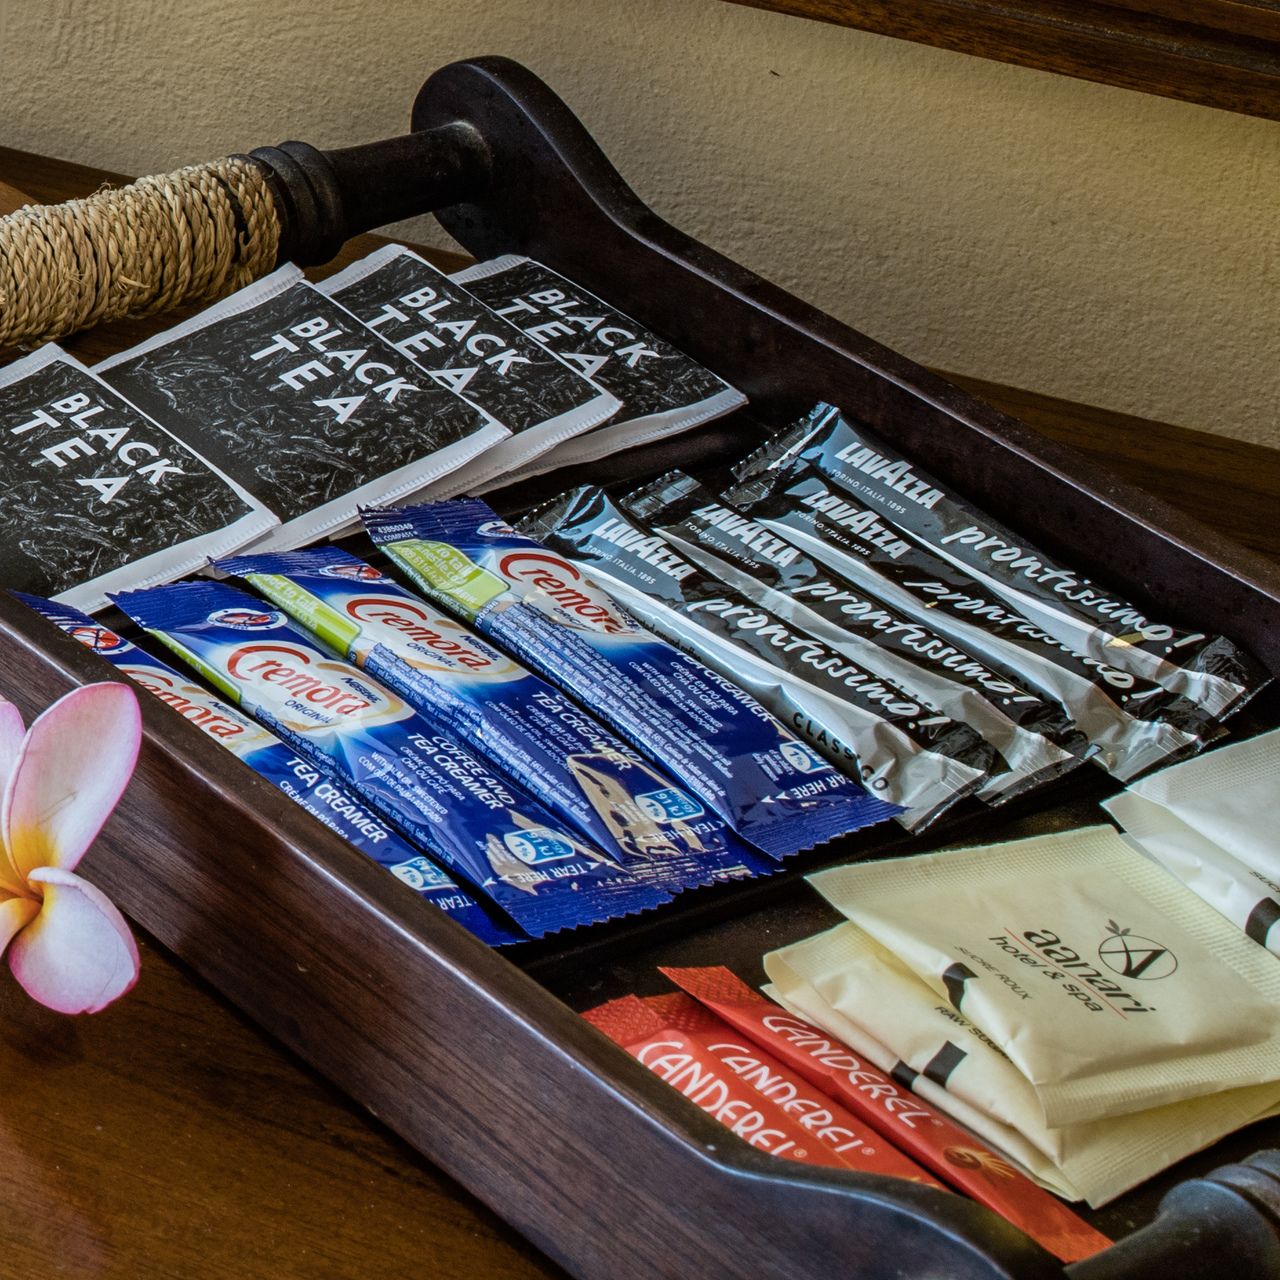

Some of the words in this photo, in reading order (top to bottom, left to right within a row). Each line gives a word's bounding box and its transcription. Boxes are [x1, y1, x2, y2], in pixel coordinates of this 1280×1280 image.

[289, 315, 420, 404] BLACK
[366, 303, 480, 394] TEA
[398, 285, 533, 376] BLACK
[495, 298, 611, 379] TEA
[528, 287, 661, 369] BLACK
[249, 333, 366, 425] TEA
[10, 409, 130, 505] TEA
[50, 391, 187, 486] BLACK
[834, 441, 946, 511] LAVAZZA
[886, 500, 908, 516] 1895
[592, 517, 697, 582] LAVAZZA
[690, 503, 805, 569] LAVAZZA
[799, 489, 914, 561] LAVAZZA
[849, 543, 873, 558] 1895
[638, 571, 657, 585] 1895
[940, 525, 1206, 653] prontissimo!
[346, 598, 493, 671] Cremora
[406, 642, 457, 668] ORIGINAL
[686, 597, 953, 731] prontissimo!
[790, 580, 1043, 706] prontissimo!
[121, 668, 246, 738] Cemora
[227, 645, 372, 716] Cremora
[284, 699, 335, 725] ORIGINAL
[641, 661, 661, 677] WITH
[657, 672, 676, 690] PALM
[684, 698, 723, 728] SWEETENED
[687, 683, 702, 696] OU
[694, 677, 710, 692] EM
[717, 695, 739, 716] PARA
[703, 668, 774, 723] CREAMER
[531, 691, 564, 714] TEA
[559, 713, 632, 771] CREAMER
[605, 735, 643, 764] AND
[286, 756, 321, 789] TEA
[314, 783, 389, 844] CREAMER
[407, 732, 440, 757] TEA
[433, 754, 504, 810] CREAMER
[415, 766, 429, 780] OU
[426, 764, 440, 778] EM
[446, 780, 466, 802] PARA
[431, 735, 491, 777] COFFEE
[478, 775, 516, 806] AND
[655, 792, 673, 805] 91
[790, 779, 827, 799] HERE
[441, 894, 474, 911] TEAR
[512, 871, 547, 884] HERE
[548, 862, 589, 879] TEAR
[988, 935, 1043, 968] hotel
[1043, 968, 1065, 981] &
[1062, 982, 1105, 1012] spa
[996, 972, 1033, 1001] ROUX
[1023, 929, 1157, 1013] aanari
[934, 1005, 971, 1028] RAW
